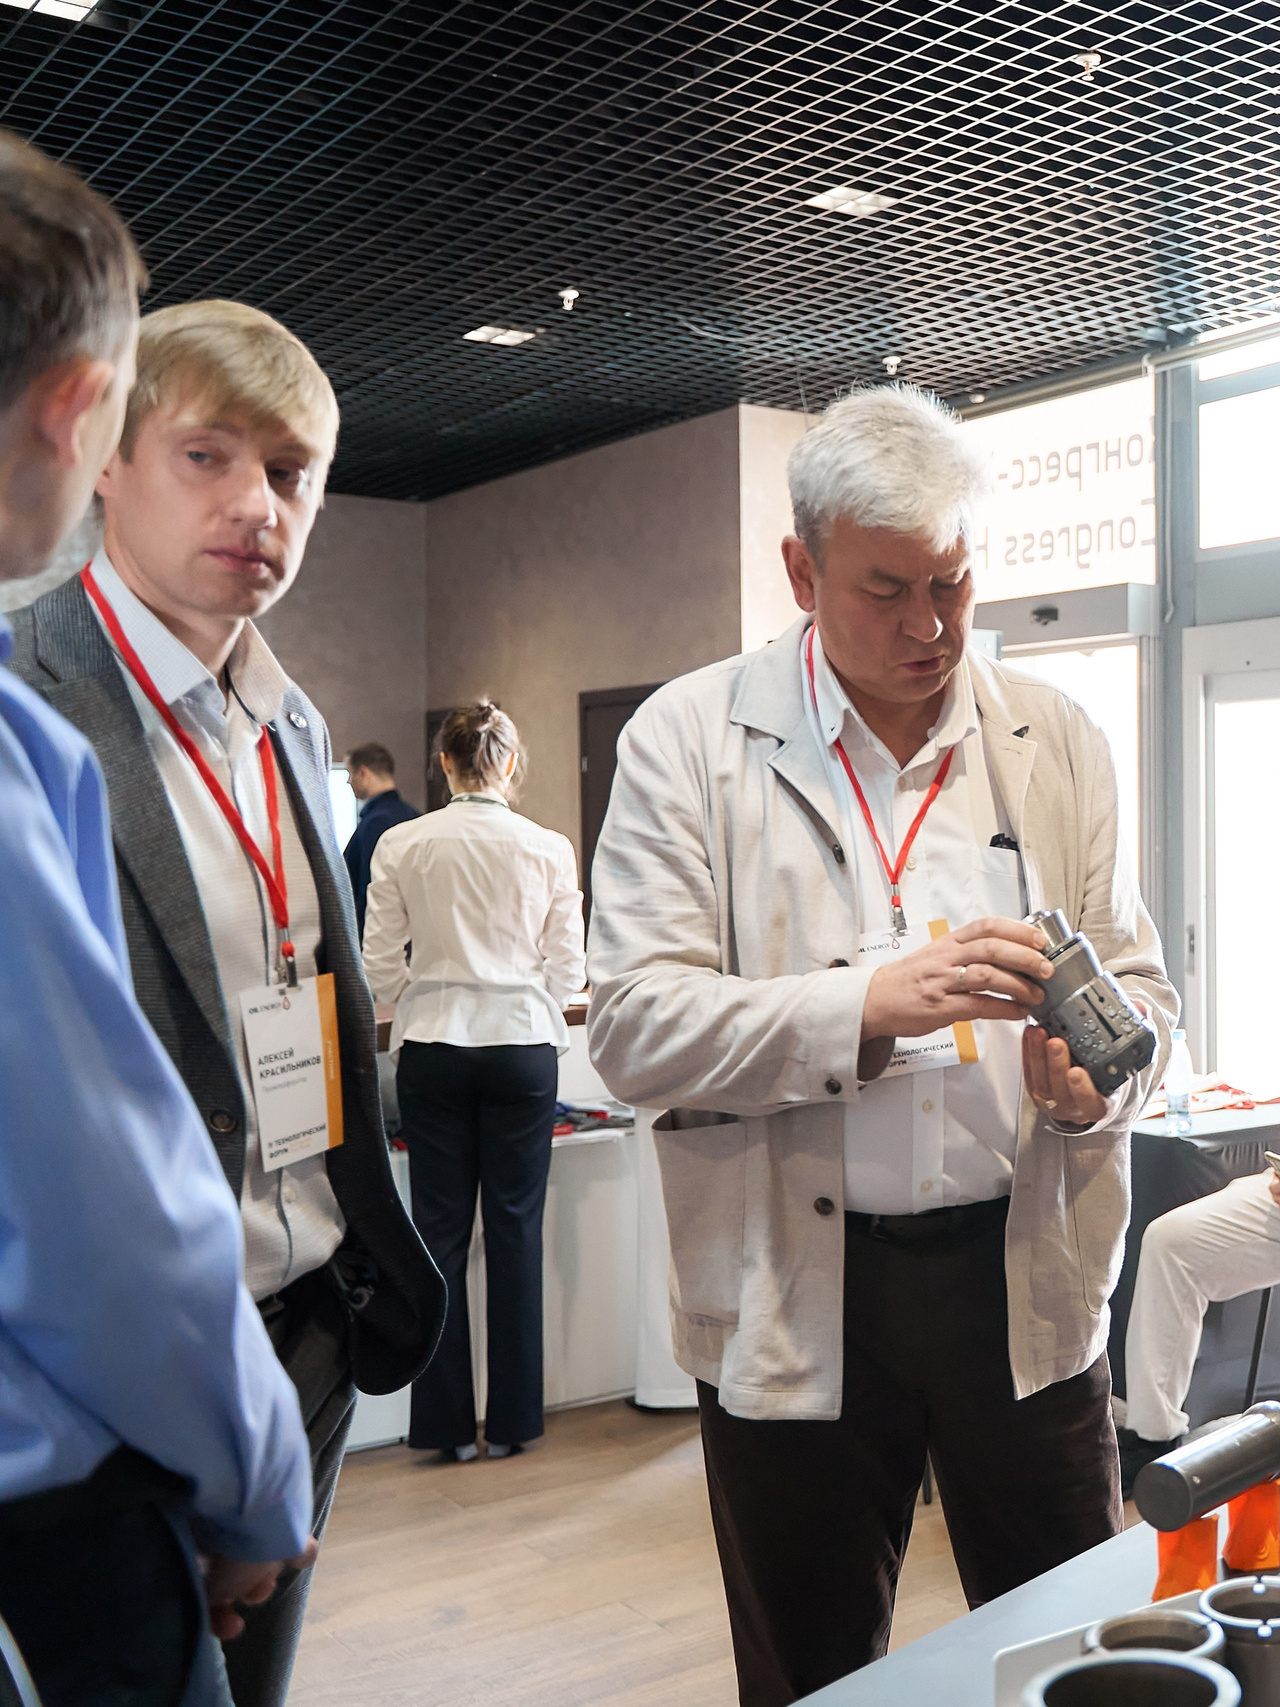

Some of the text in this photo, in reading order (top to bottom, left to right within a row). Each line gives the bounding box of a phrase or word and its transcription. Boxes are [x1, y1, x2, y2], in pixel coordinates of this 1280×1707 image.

[258, 1047, 295, 1066] АЛЕКСЕЙ
[889, 1059, 907, 1067] ОРУМ
[260, 1056, 321, 1079] КРАСИЛЬНИКОВ
